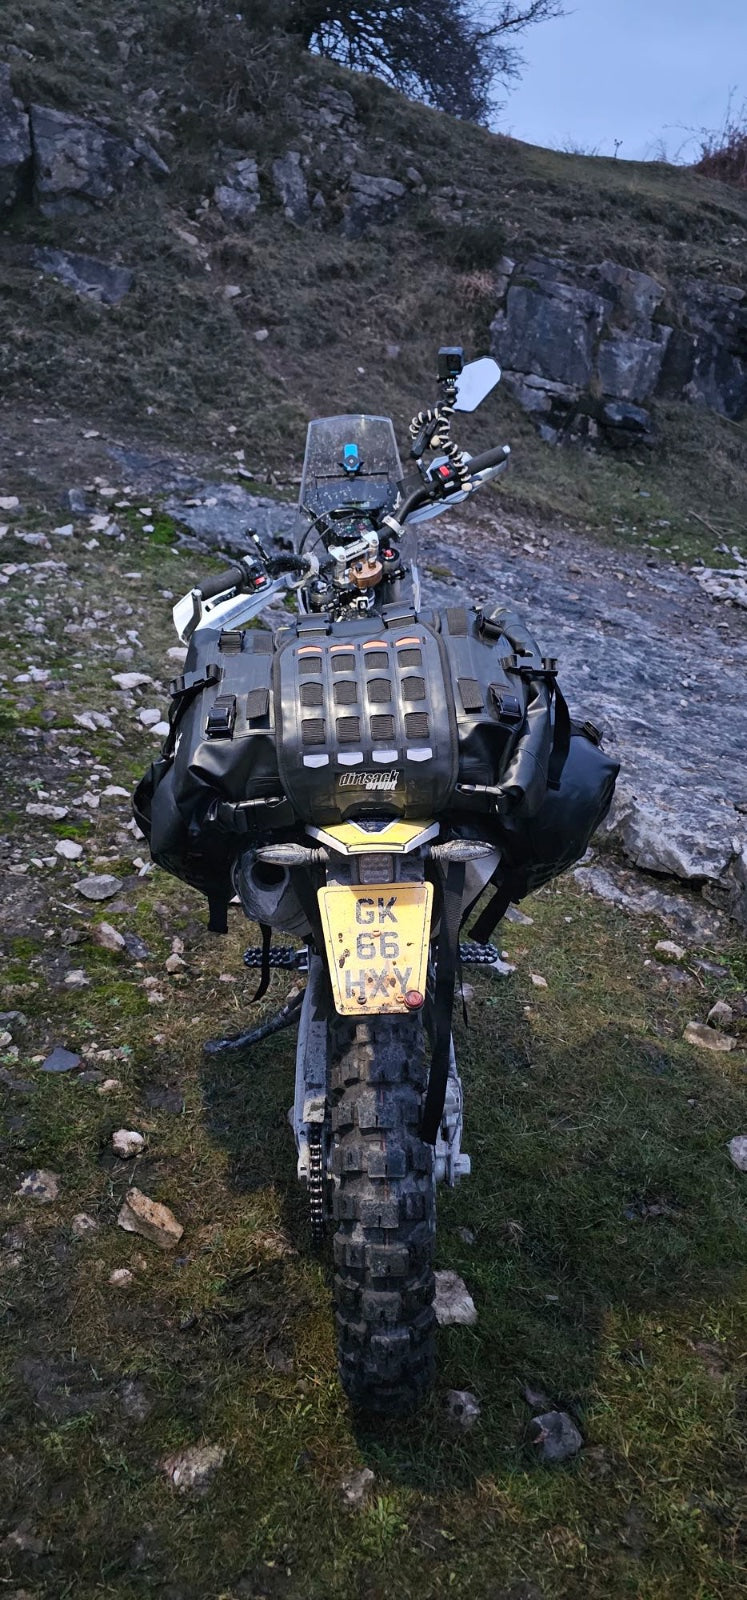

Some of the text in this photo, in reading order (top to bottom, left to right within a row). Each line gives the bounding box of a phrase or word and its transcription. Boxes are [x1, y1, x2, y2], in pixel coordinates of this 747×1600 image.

[338, 769, 400, 787] dirtsack
[356, 896, 398, 925] GK
[356, 931, 400, 960] 66
[344, 967, 412, 999] HXY
